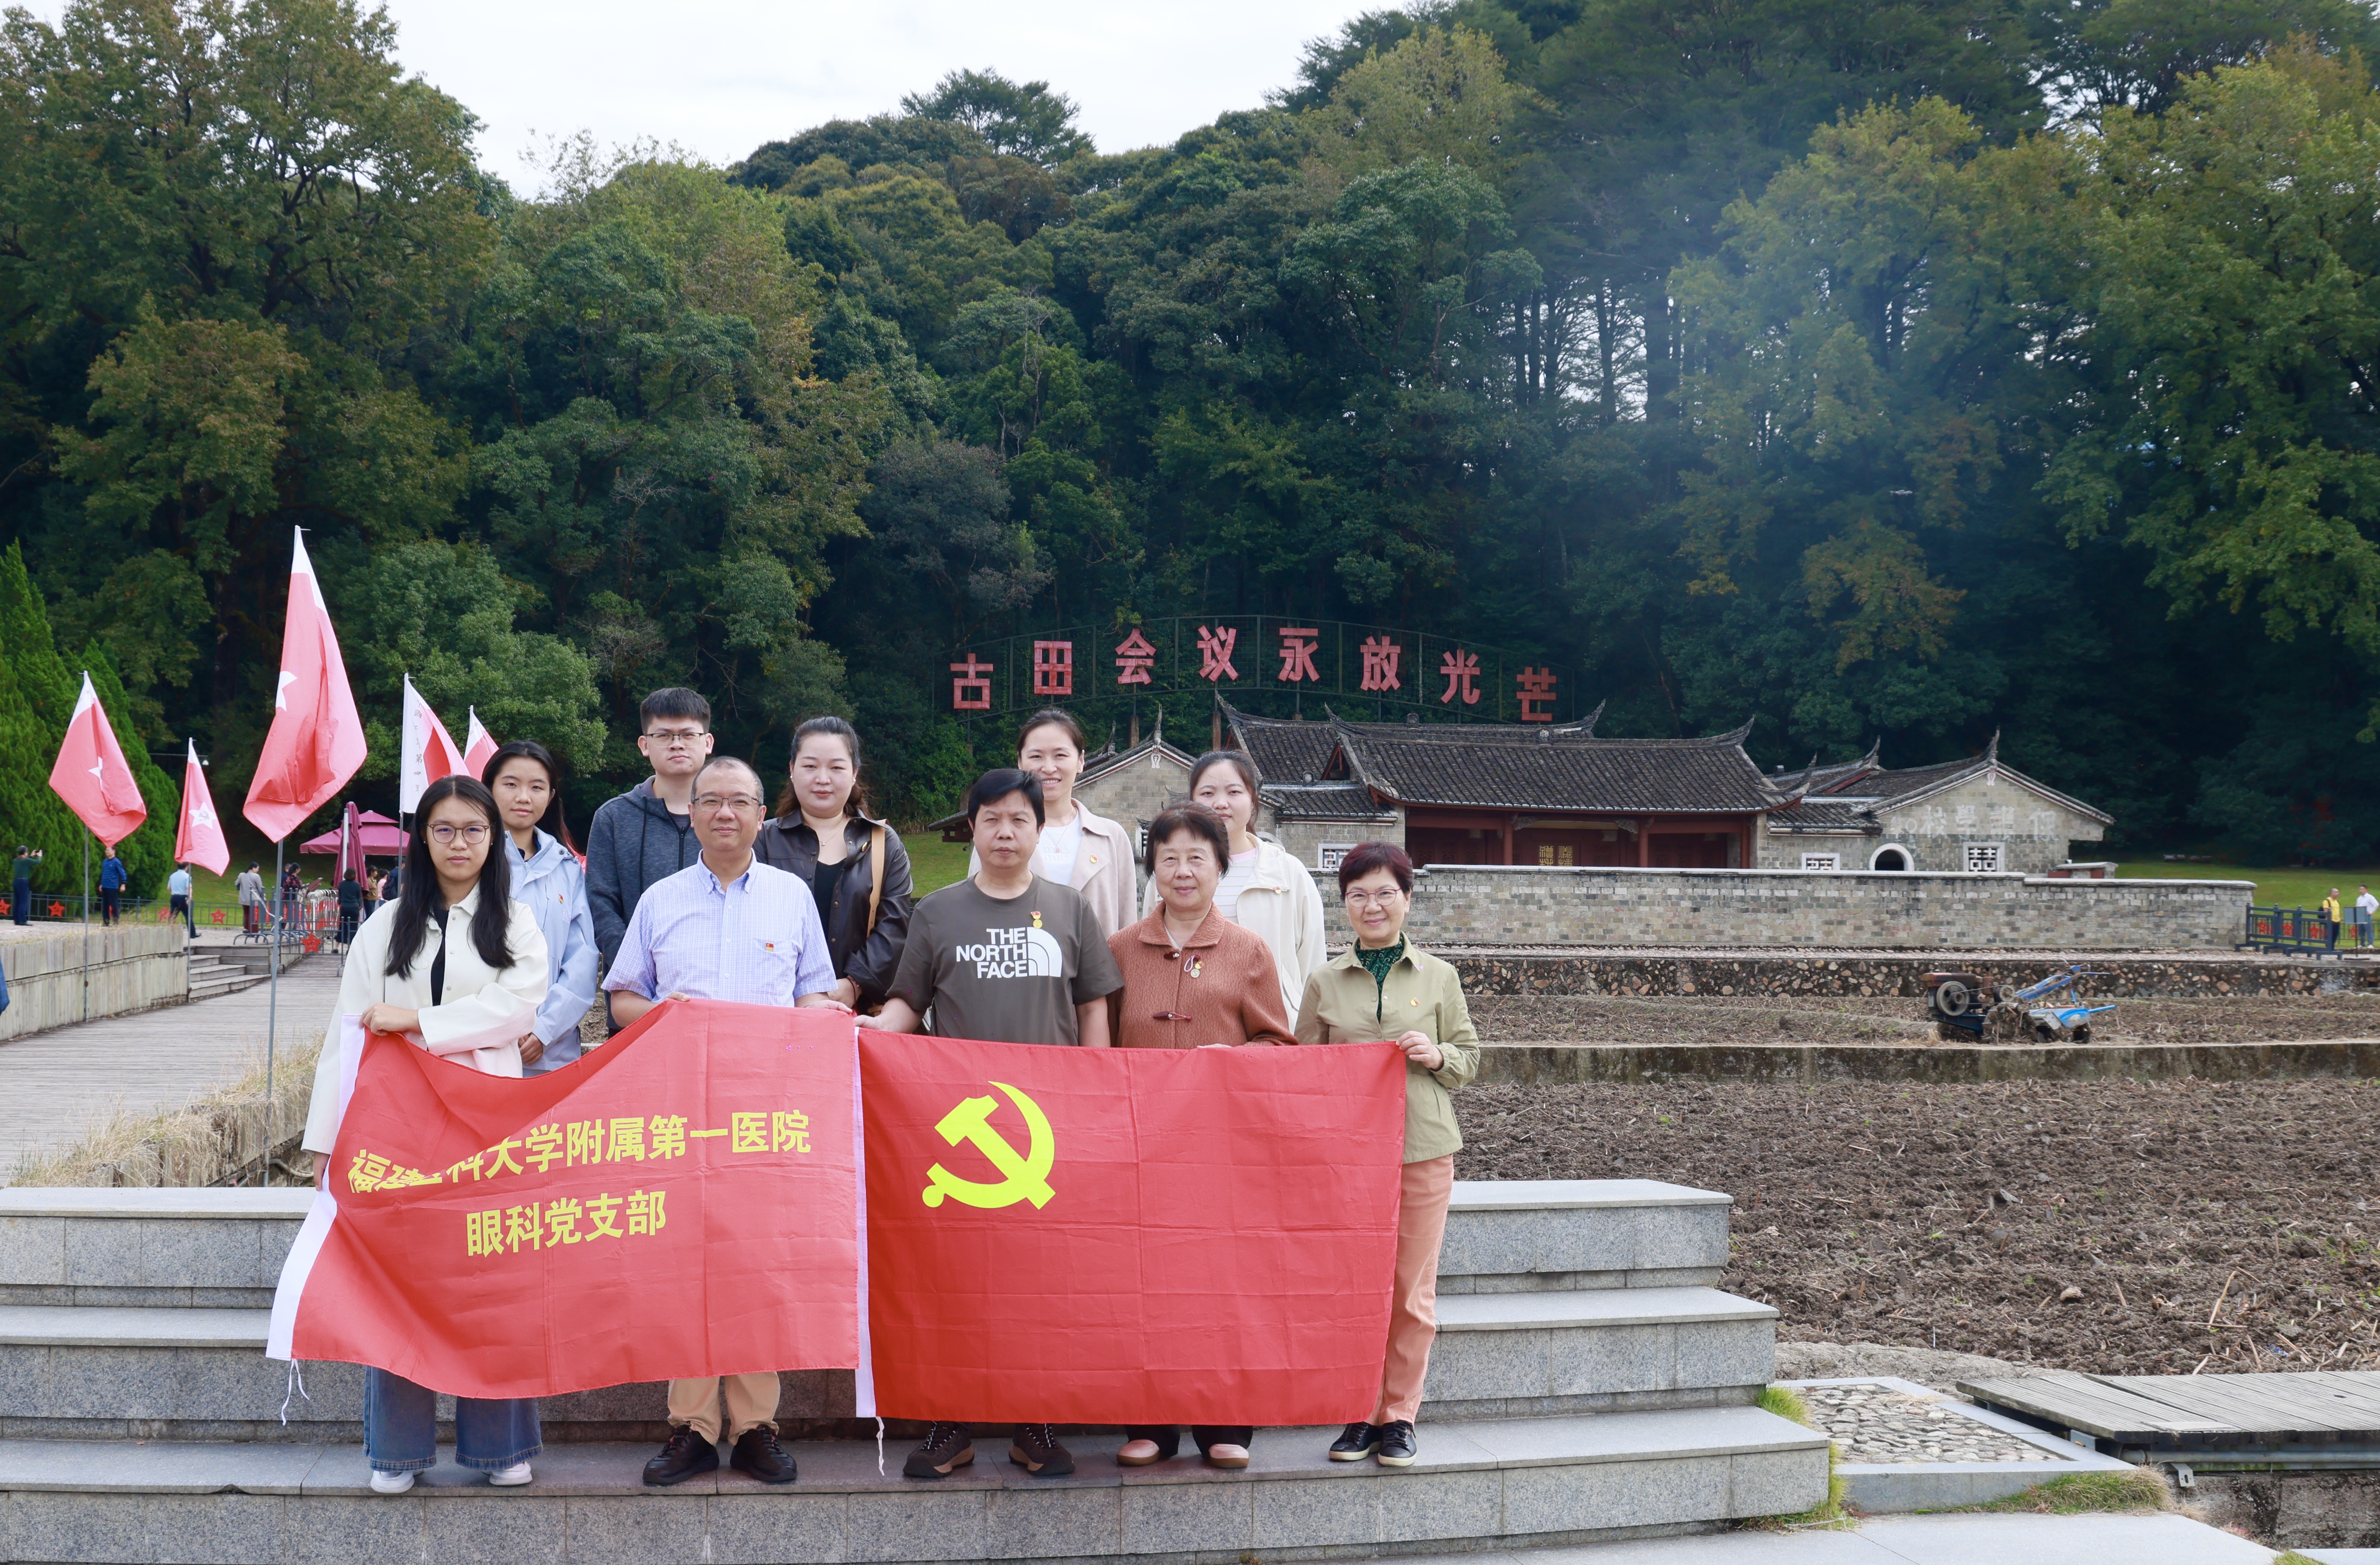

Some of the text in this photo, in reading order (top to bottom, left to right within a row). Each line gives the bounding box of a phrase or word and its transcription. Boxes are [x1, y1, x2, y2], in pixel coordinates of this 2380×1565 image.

[950, 625, 1557, 721] 古田会议永放光芒
[956, 944, 1027, 962] NORTH
[986, 927, 1026, 944] THE
[977, 959, 1028, 979] FACE
[348, 1109, 811, 1193] 福建科大学附属第一医院
[466, 1189, 666, 1258] 眼科党支部
